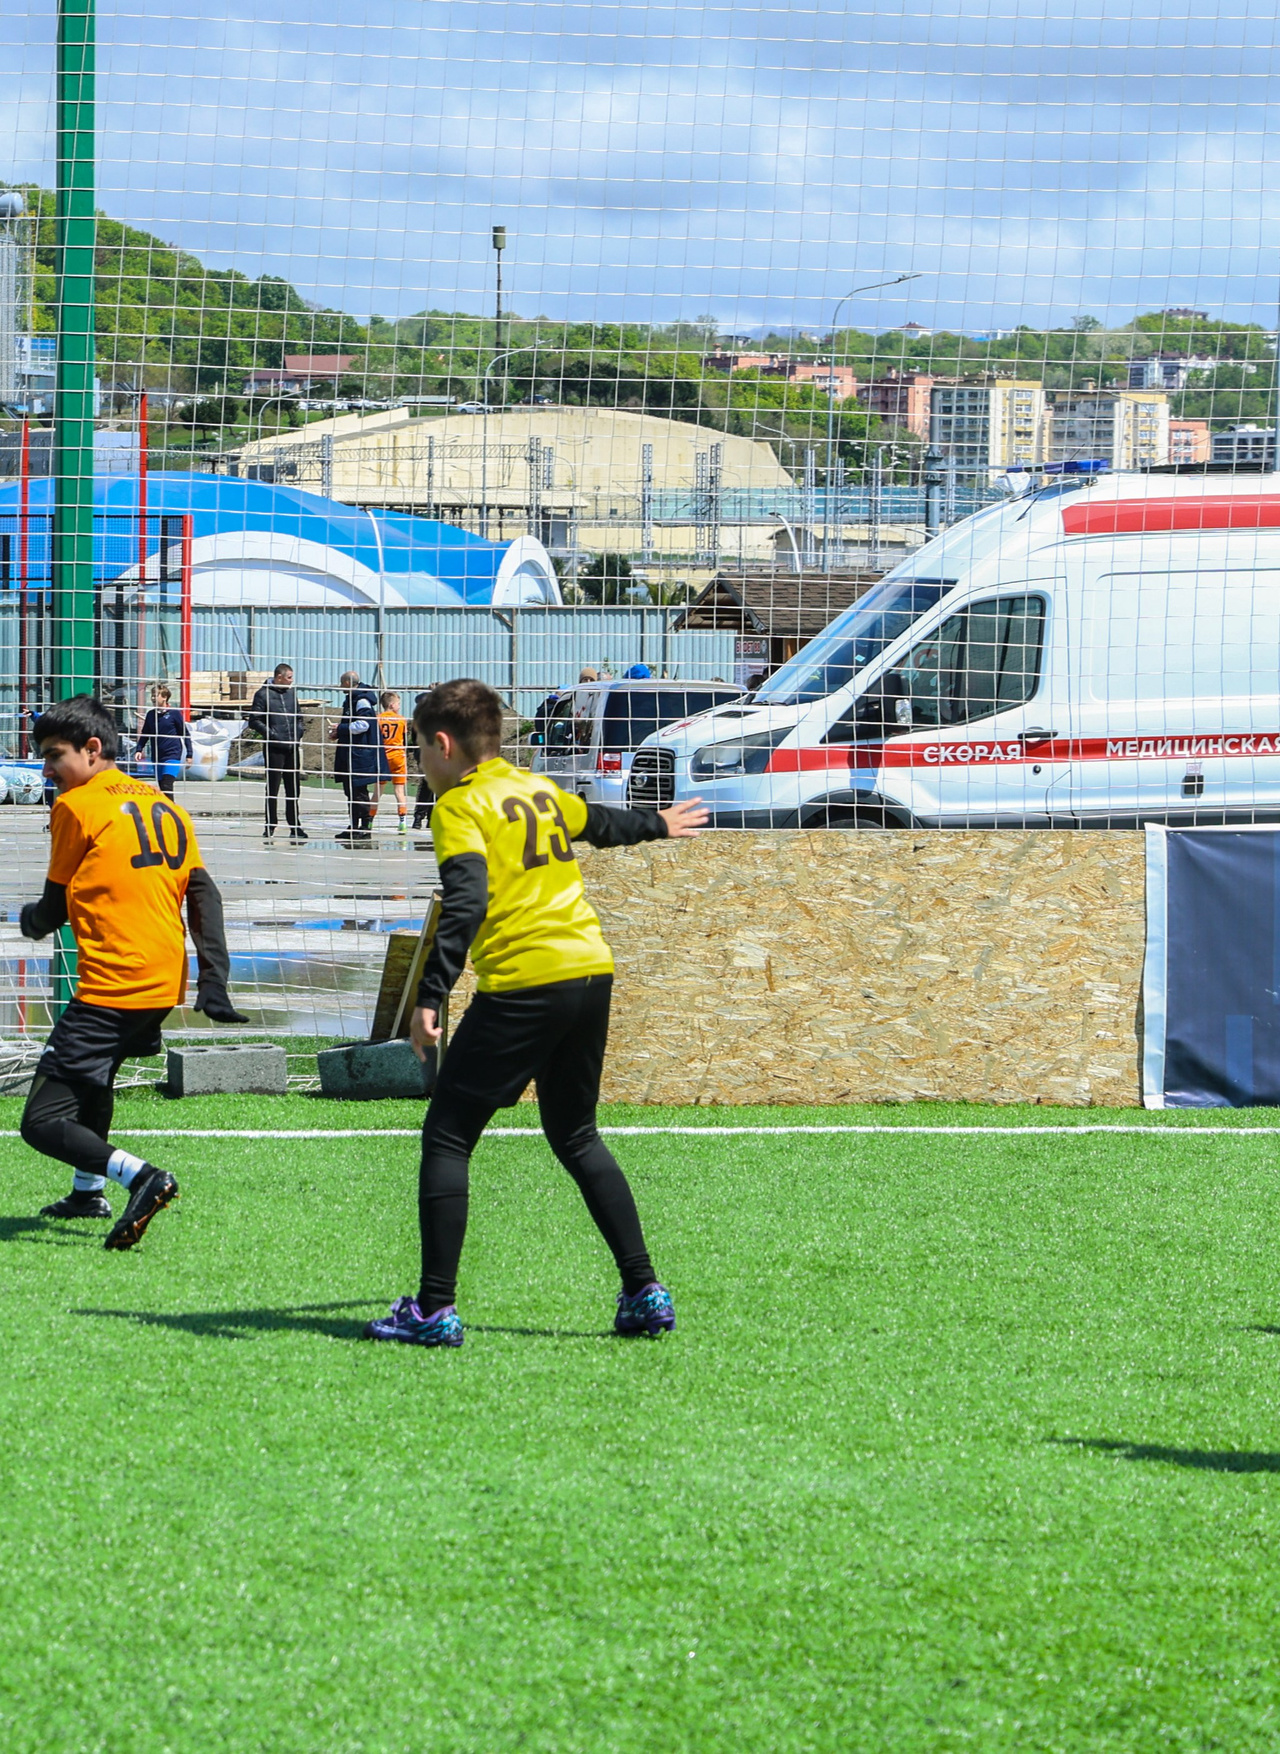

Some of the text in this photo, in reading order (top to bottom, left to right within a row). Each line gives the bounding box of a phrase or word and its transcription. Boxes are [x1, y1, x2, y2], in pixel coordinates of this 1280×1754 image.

[382, 723, 398, 739] 37
[923, 744, 1021, 763] СКОРАЯ
[120, 801, 187, 870] 10
[502, 790, 574, 871] 23
